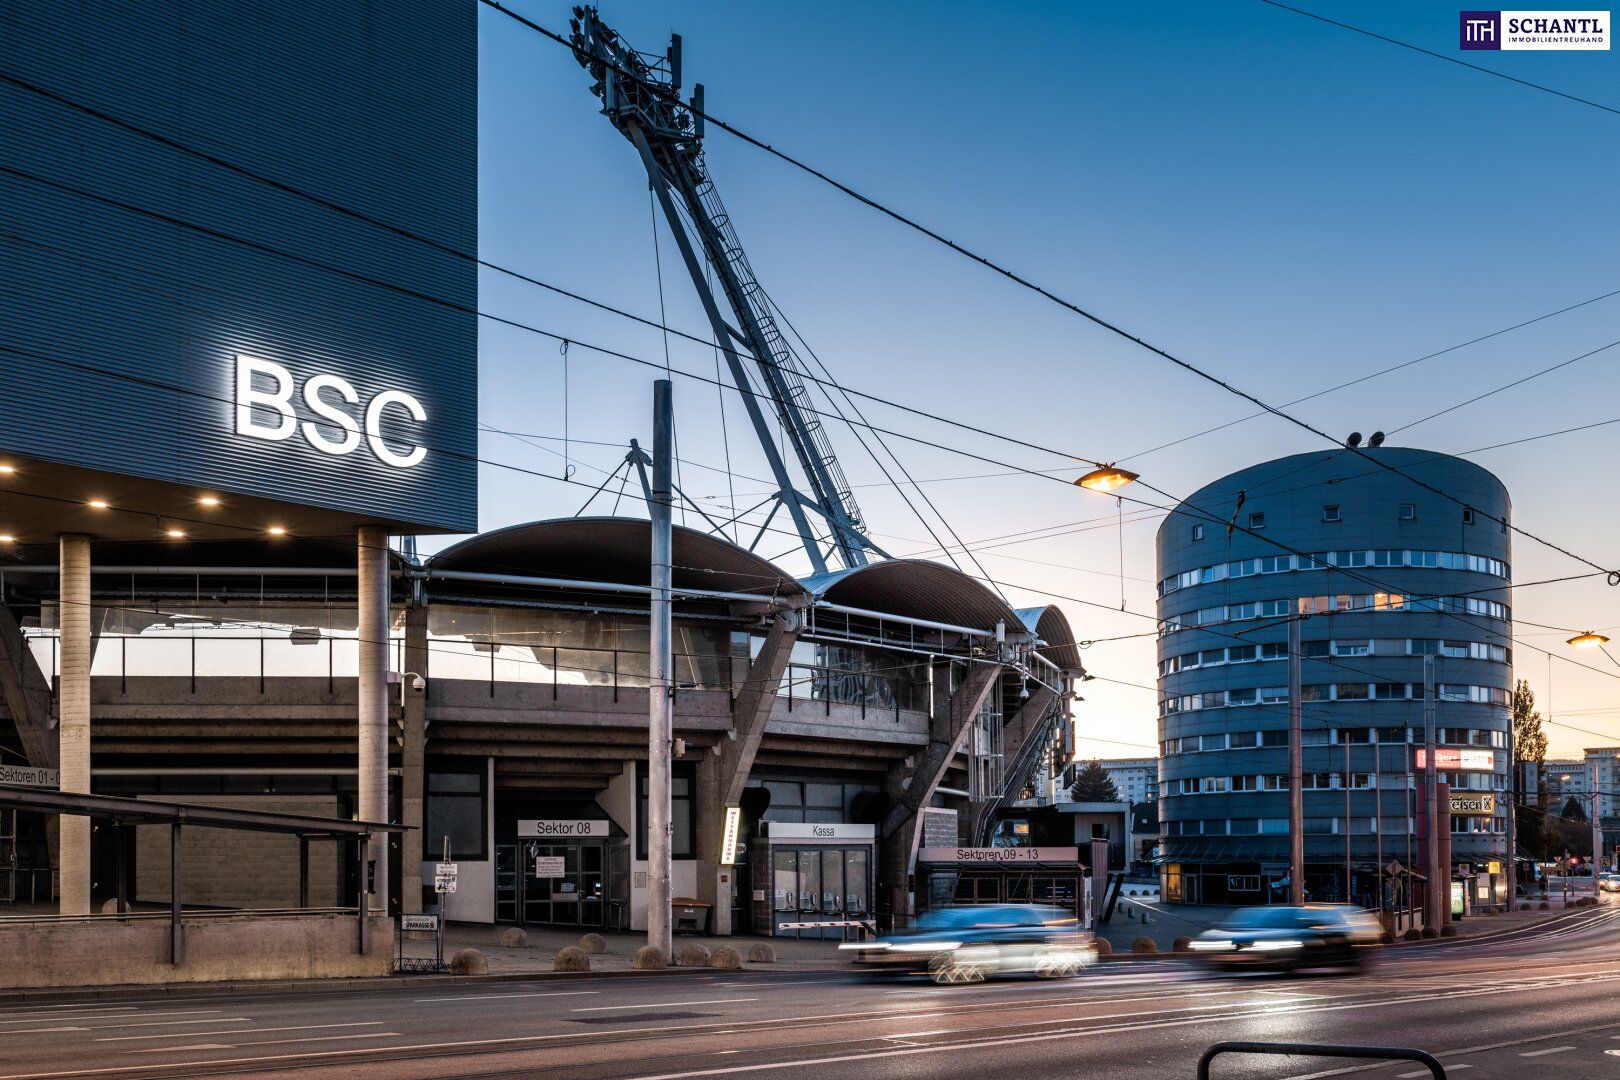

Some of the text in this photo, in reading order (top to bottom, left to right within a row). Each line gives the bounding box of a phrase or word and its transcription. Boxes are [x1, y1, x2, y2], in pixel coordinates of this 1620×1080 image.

[235, 353, 429, 468] BSC
[0, 767, 36, 783] Sektoren
[38, 770, 48, 784] 01
[1450, 795, 1482, 811] eisen
[536, 821, 591, 835] Sektor 08
[812, 825, 835, 837] Kassa
[956, 849, 1001, 860] Sektoren
[1003, 849, 1017, 860] 09
[1026, 848, 1039, 860] 13
